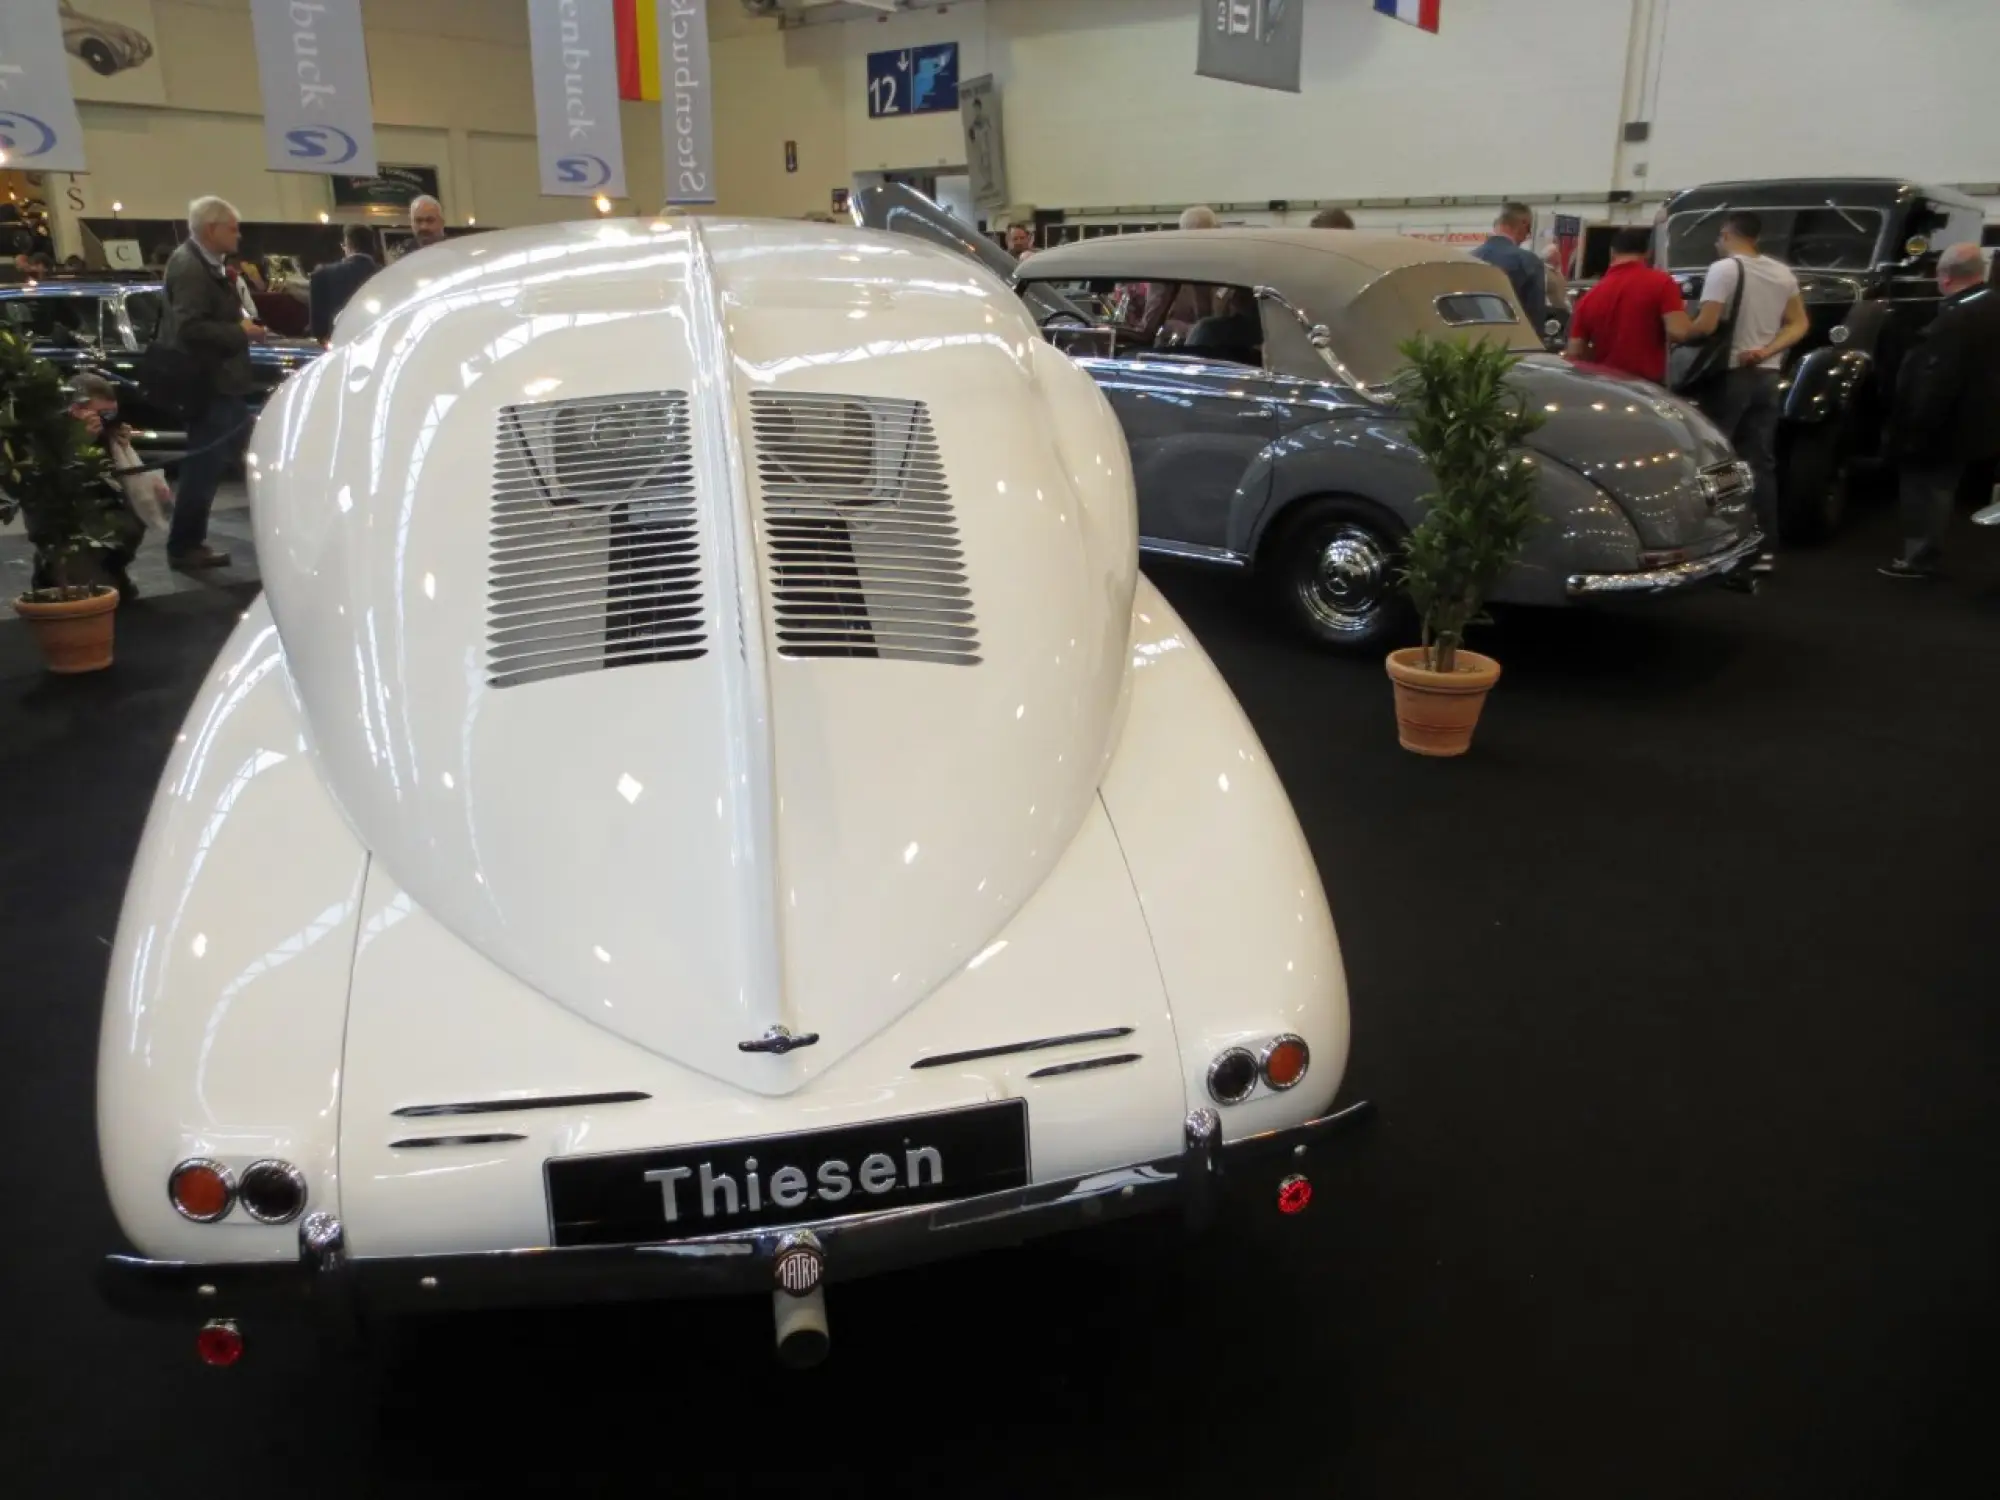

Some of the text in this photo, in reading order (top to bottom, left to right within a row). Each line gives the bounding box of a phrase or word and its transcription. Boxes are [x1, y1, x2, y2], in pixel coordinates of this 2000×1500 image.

[869, 76, 899, 114] 12
[643, 1145, 943, 1222] Thiesen
[778, 1251, 819, 1290] TATRA
